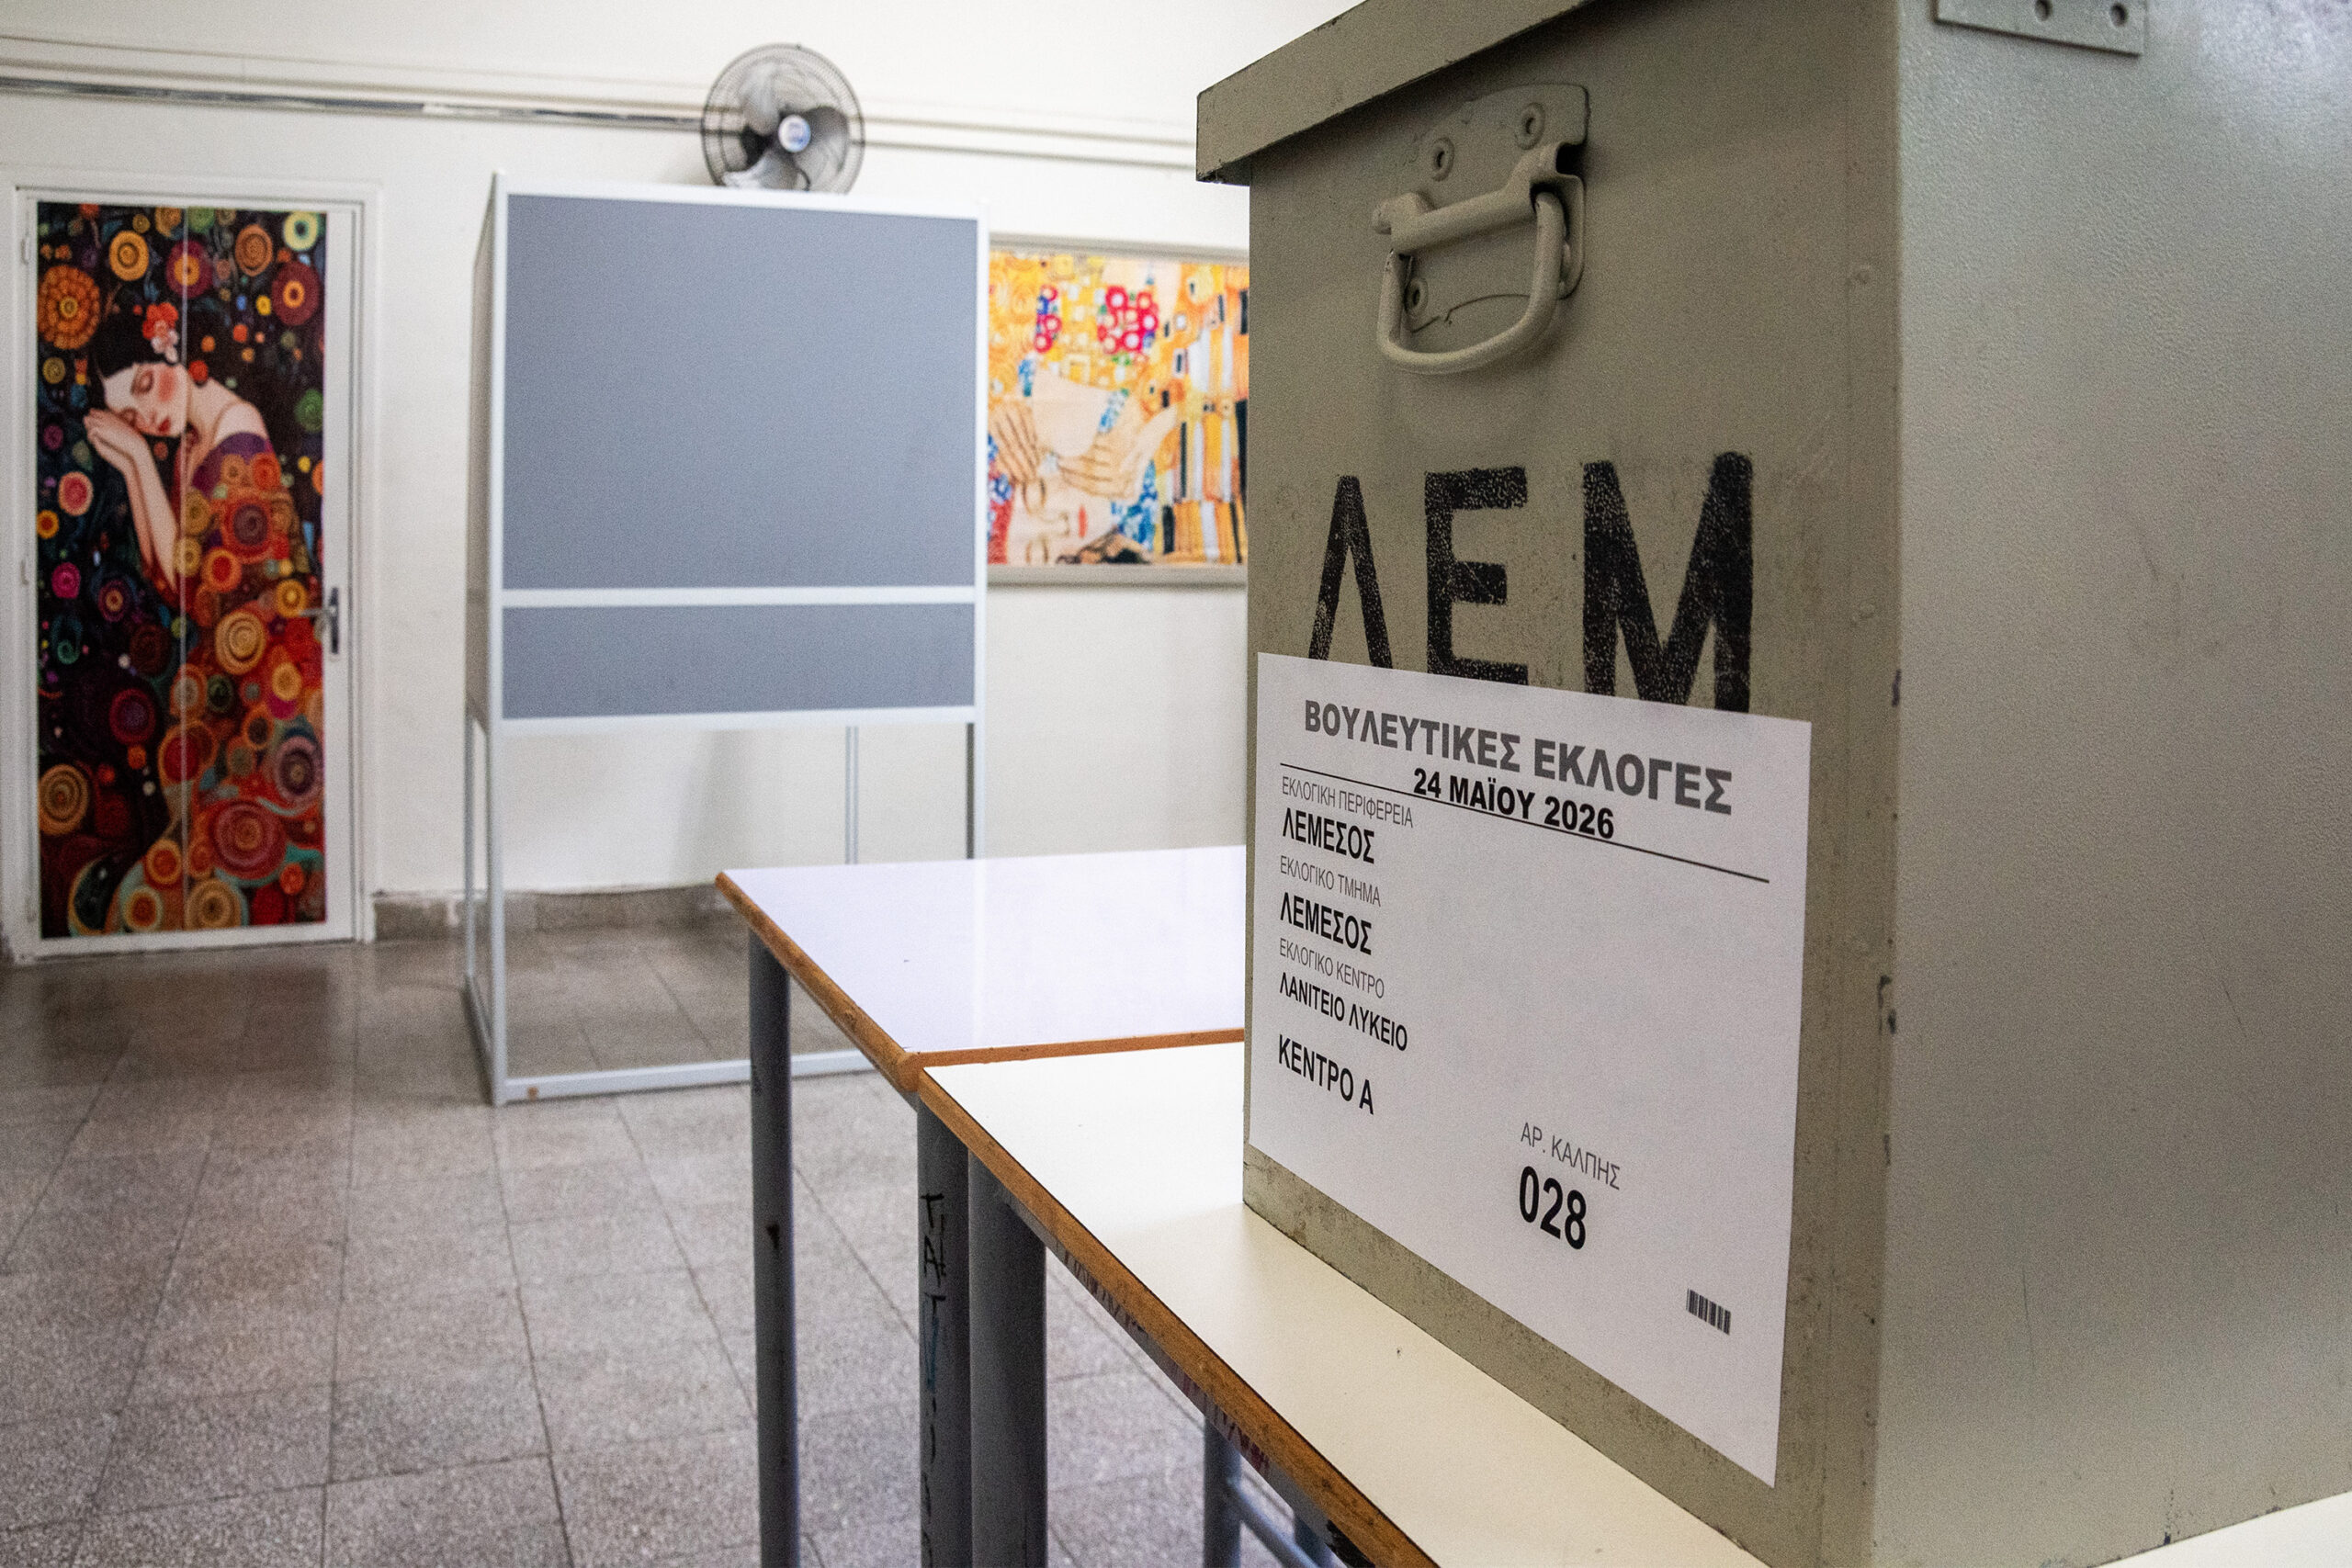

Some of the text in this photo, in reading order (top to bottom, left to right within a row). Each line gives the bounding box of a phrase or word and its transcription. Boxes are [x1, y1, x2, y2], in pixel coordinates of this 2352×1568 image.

[1307, 450, 1752, 713] ΛΕΜ
[1305, 699, 1732, 816] ΒΟΥΛΕΥΤΙΚΕΣ ΕΚΛΟΓΕΣ
[1282, 775, 1413, 828] ΕΚΛΟΓΙΚΗ ΠΕΡΙΦΕΡΕΙΑ
[1283, 807, 1374, 864] ΛΕΜΕΣΟΣ
[1413, 767, 1614, 840] 24 ΜΑΪΟΥ 2026
[1280, 855, 1381, 908] ΕΚΛΟΓΙΚΟ ΤΜΗΜΑ
[1280, 892, 1372, 955] ΛΕΜΕΣΟΣ
[1280, 938, 1385, 998] ΕΚΛΟΓΙΚΟ ΚΕΝΤΡΟ
[1280, 972, 1408, 1051] ΛΑΝΙΤΕΙΟ ΛΥΚΕΙΟ
[1279, 1033, 1374, 1115] ΚΕΝΤΡΟ Α
[1521, 1122, 1620, 1190] ΑΡ. ΚΑΛΠΗΣ
[1520, 1166, 1587, 1250] 028
